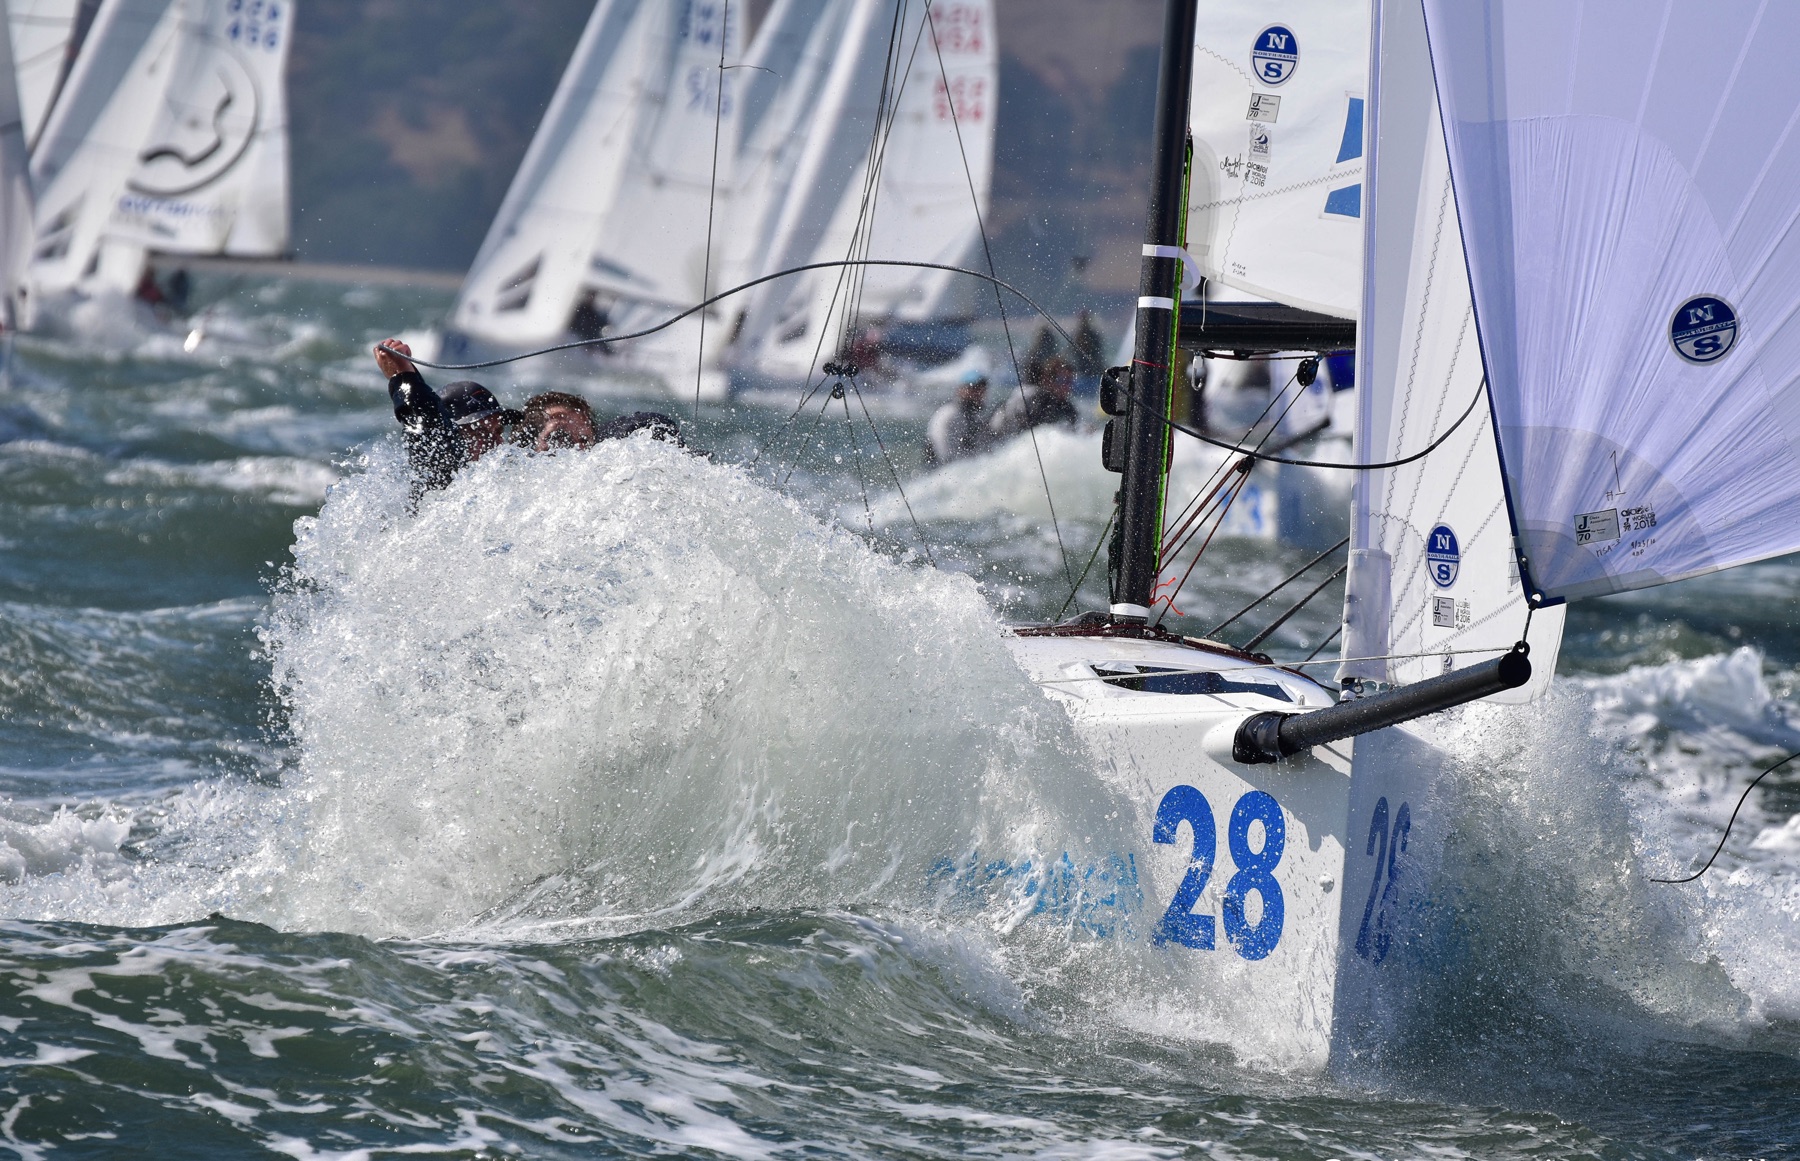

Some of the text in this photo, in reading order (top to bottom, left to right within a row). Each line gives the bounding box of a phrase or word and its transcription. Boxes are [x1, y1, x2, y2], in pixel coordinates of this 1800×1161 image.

[1266, 32, 1289, 50] N
[1264, 62, 1283, 78] S
[1253, 96, 1262, 107] J
[1250, 176, 1265, 187] 2016
[1686, 303, 1716, 326] N
[1693, 334, 1724, 356] S
[1633, 519, 1657, 531] 2016
[1435, 533, 1451, 550] N
[1578, 533, 1591, 542] 70
[1437, 563, 1451, 581] S
[1434, 615, 1442, 623] 70
[1152, 784, 1286, 961] 28
